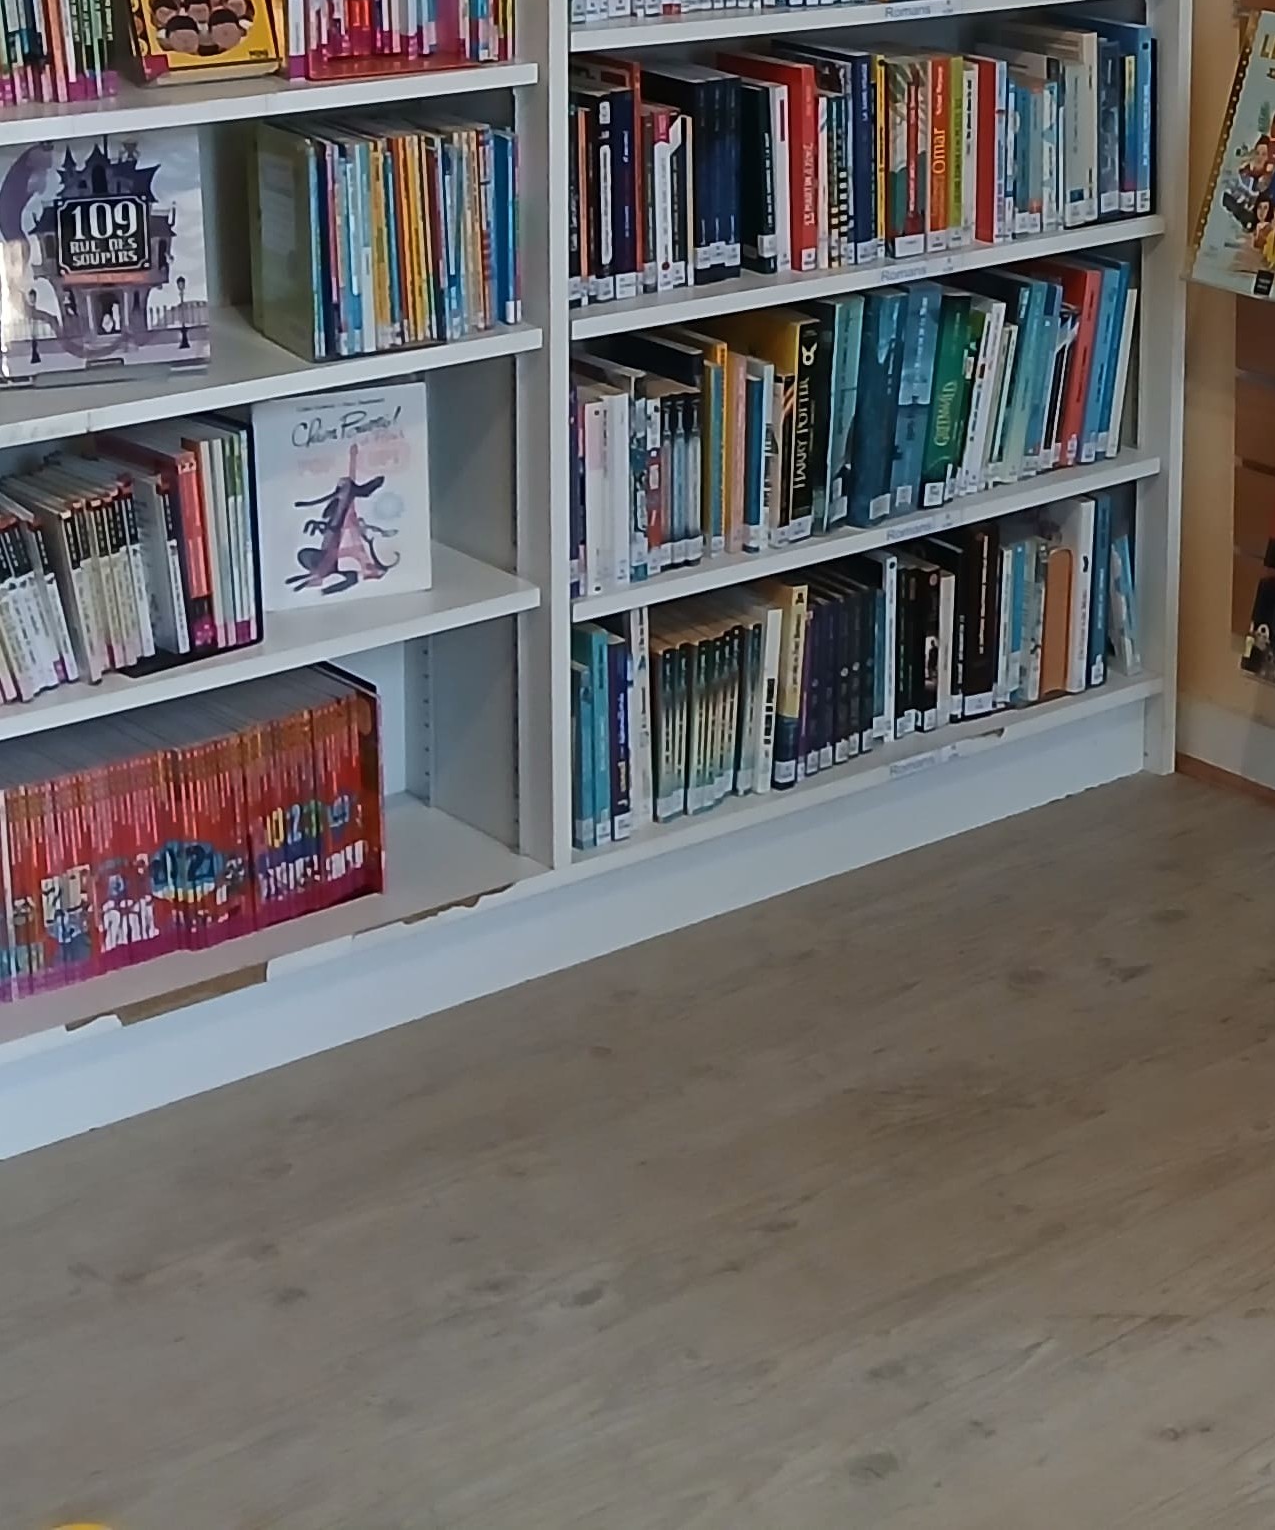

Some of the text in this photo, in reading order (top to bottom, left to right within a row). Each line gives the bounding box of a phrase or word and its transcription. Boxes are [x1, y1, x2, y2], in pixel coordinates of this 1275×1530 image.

[885, 5, 931, 19] Romans
[933, 127, 946, 174] Omar
[70, 201, 138, 240] 109
